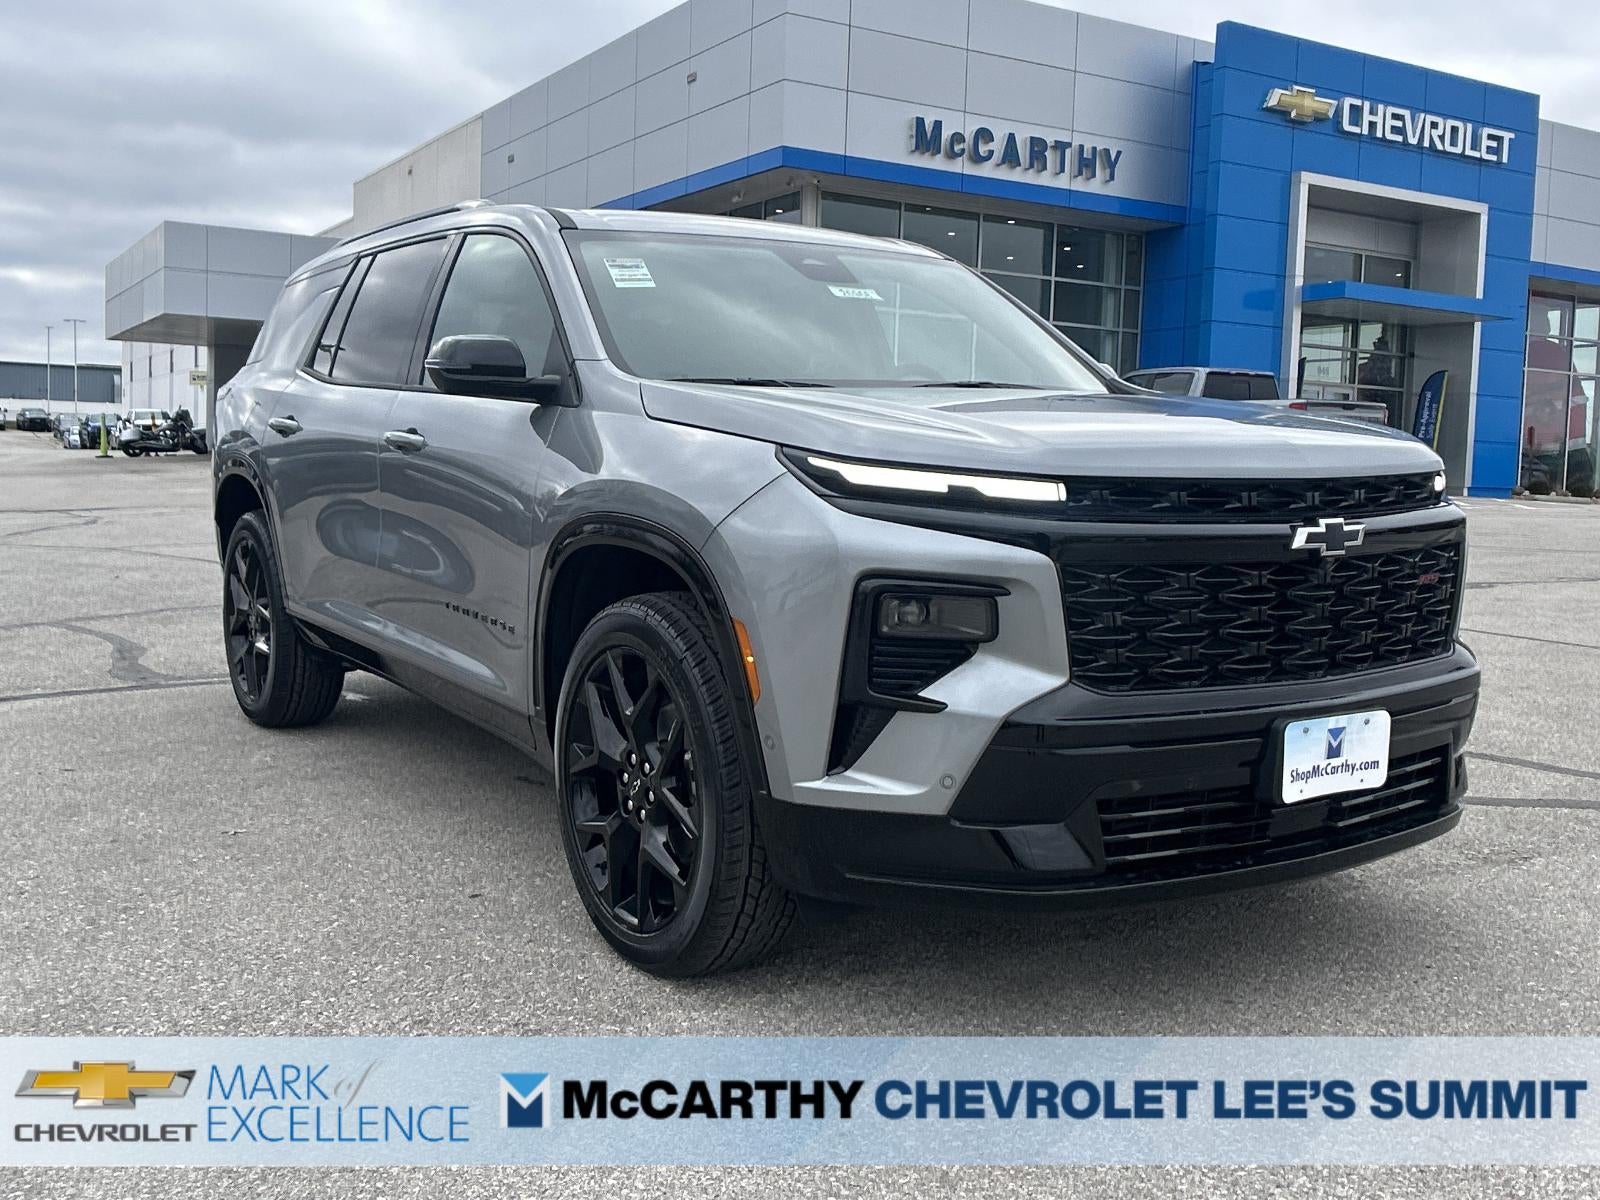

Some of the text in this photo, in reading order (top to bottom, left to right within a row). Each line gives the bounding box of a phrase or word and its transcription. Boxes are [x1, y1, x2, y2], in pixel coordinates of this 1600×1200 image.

[912, 116, 1122, 182] McCARTHY
[1340, 97, 1515, 164] CHEVROLET
[1290, 759, 1380, 784] ShopMcCarthy.com
